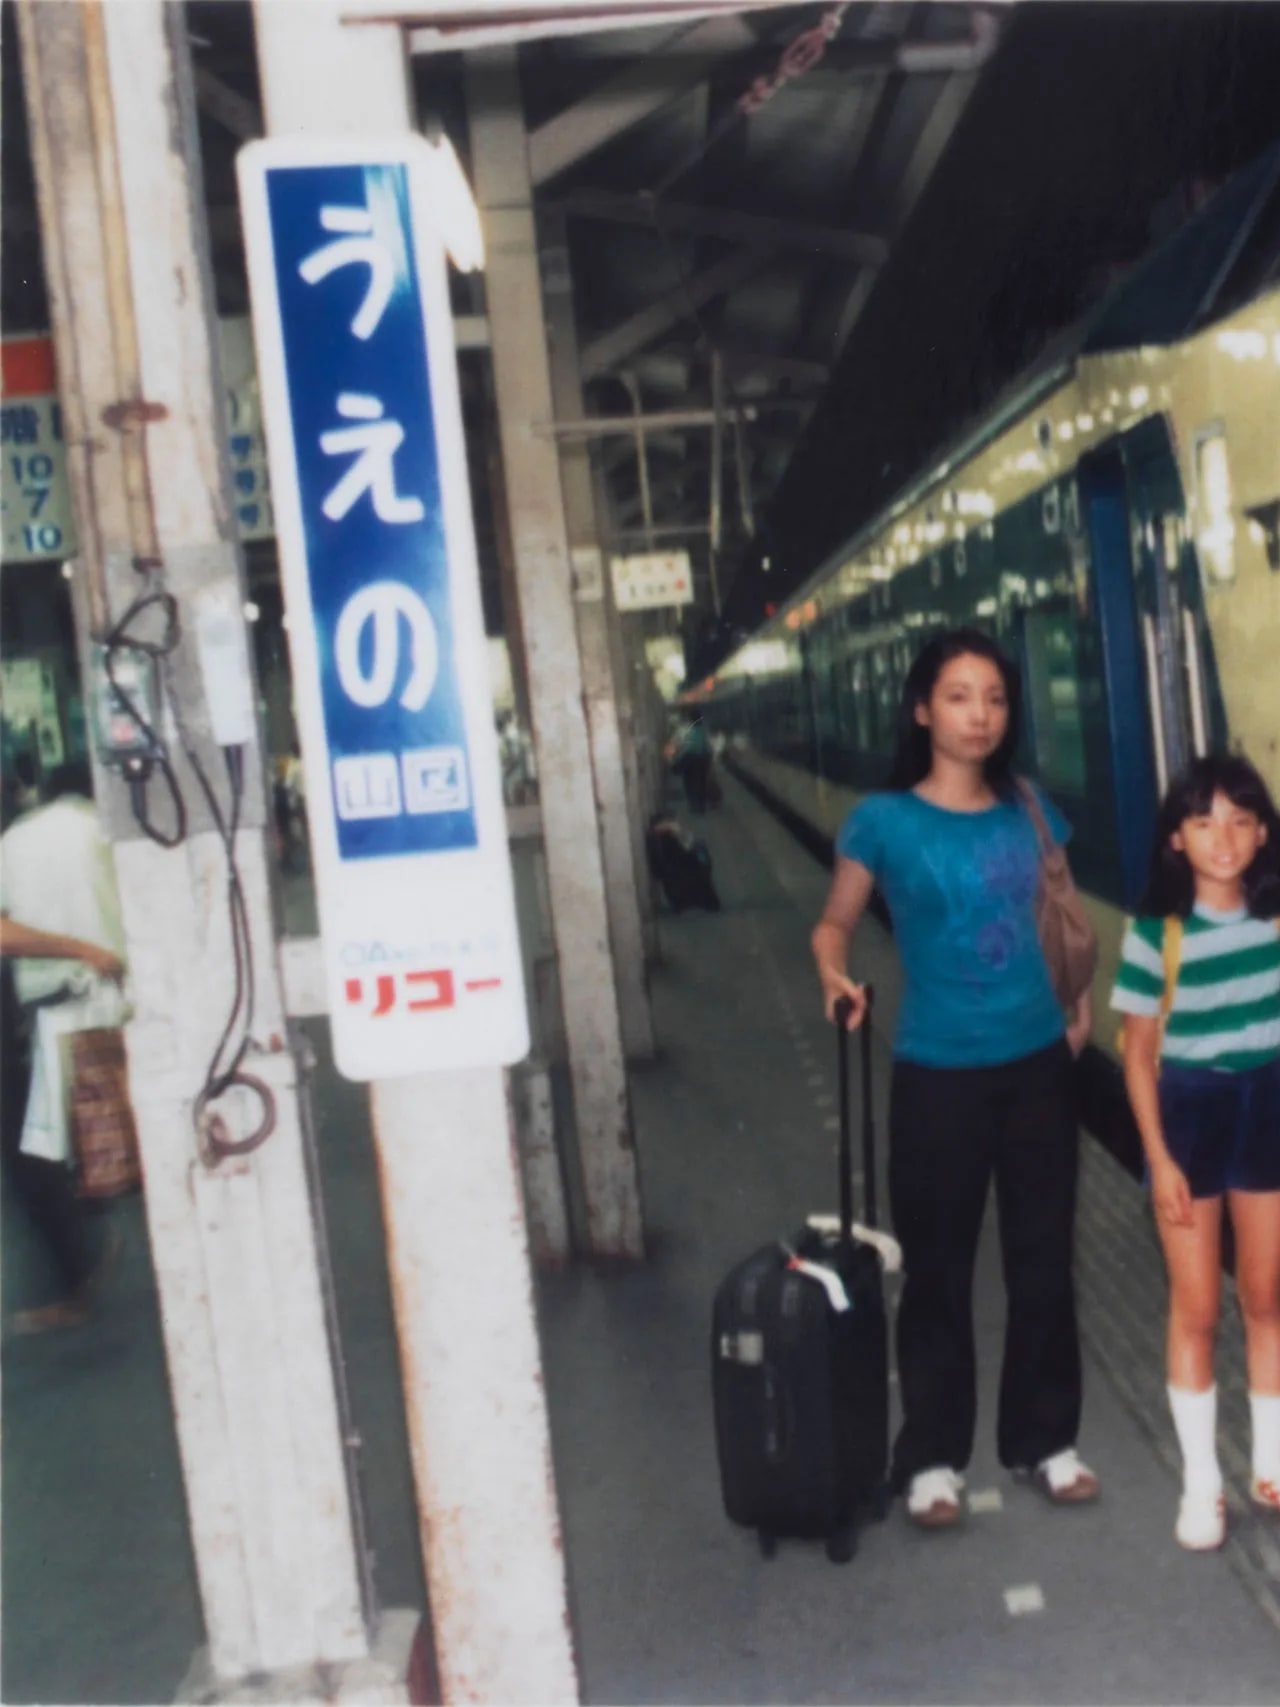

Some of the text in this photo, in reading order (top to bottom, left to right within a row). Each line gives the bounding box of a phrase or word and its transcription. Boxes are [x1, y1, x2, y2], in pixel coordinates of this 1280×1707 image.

[299, 205, 438, 714] うえの
[344, 968, 502, 1018] リコー
